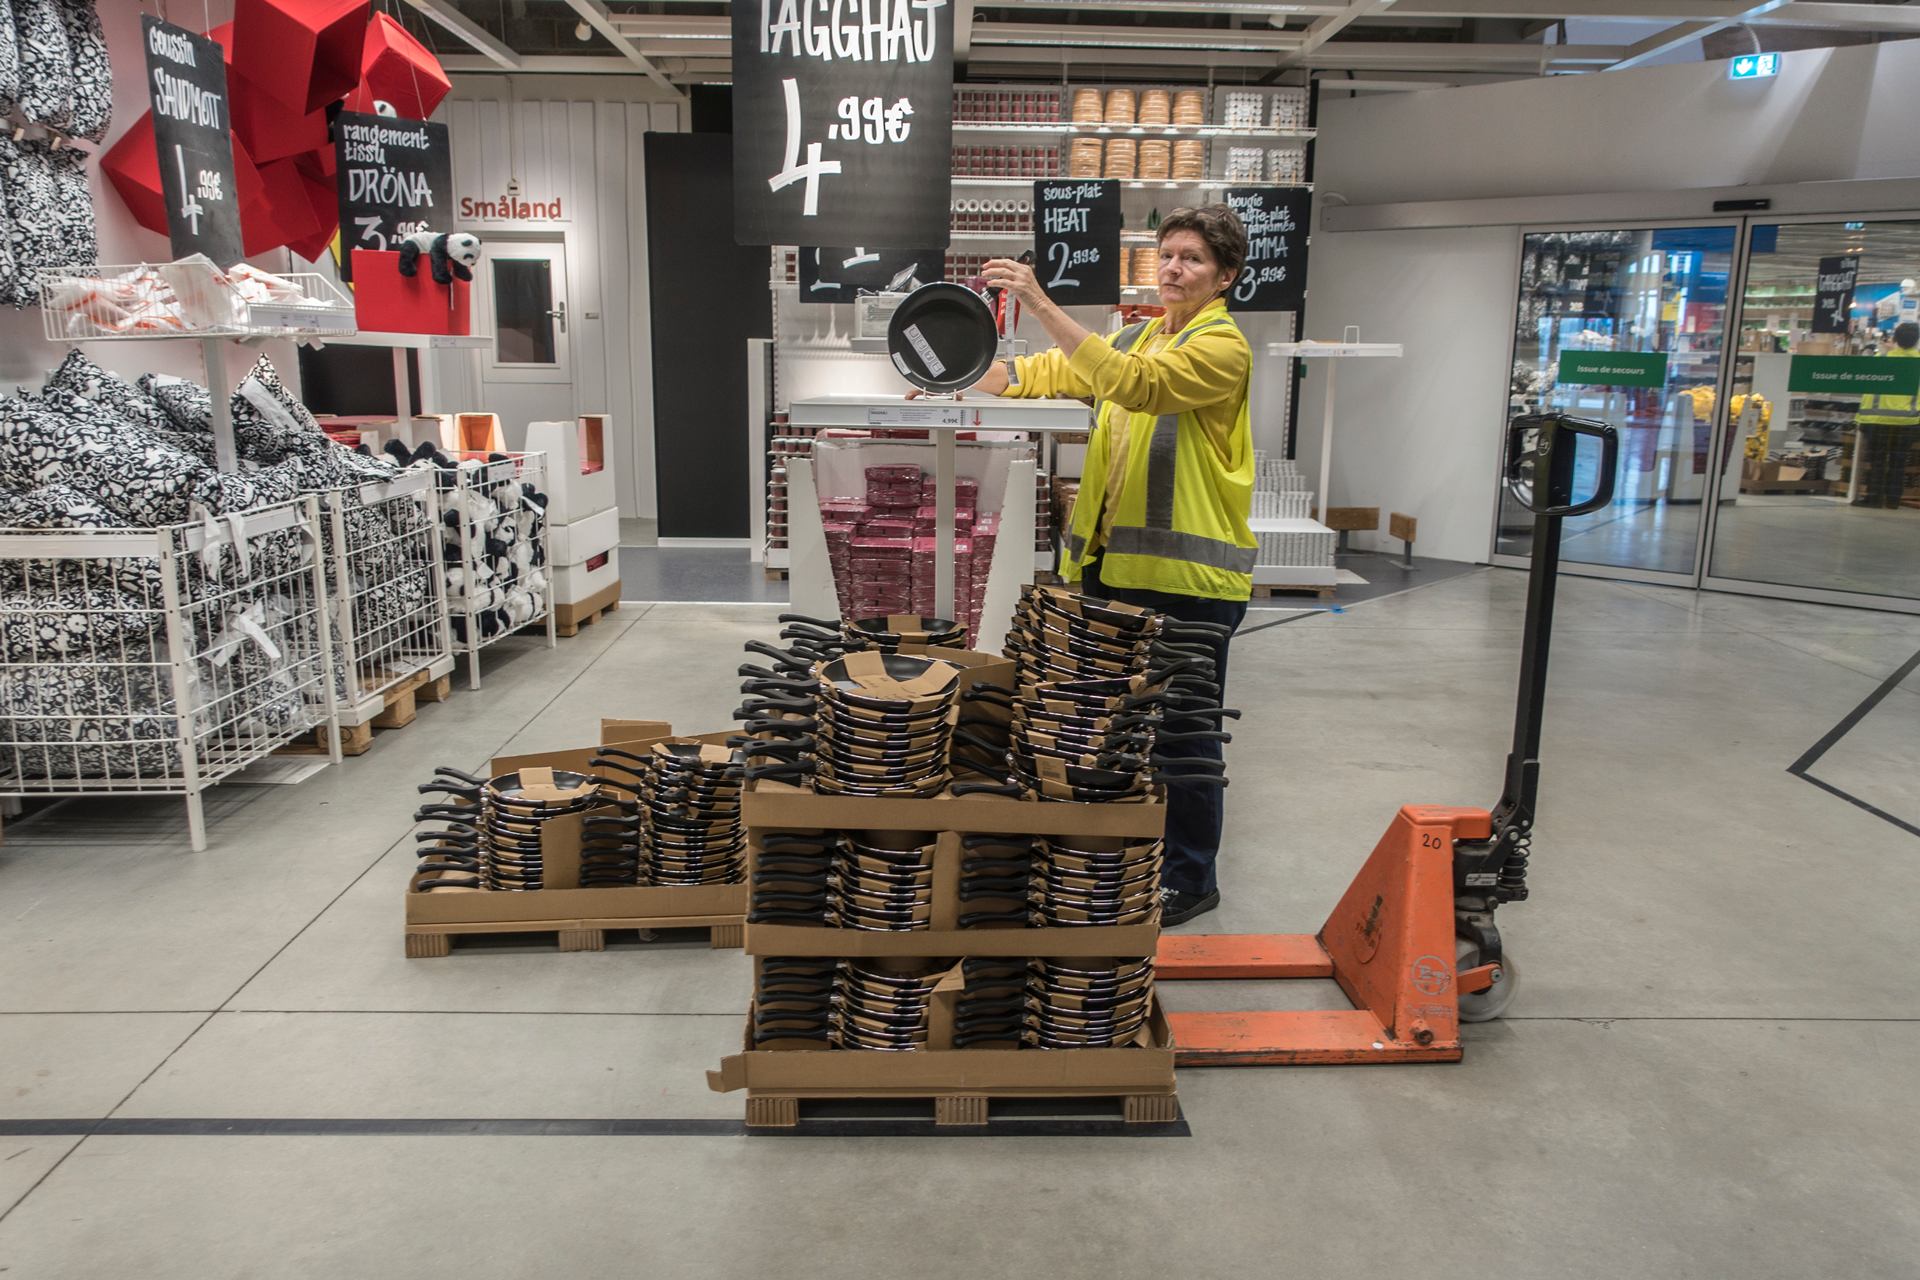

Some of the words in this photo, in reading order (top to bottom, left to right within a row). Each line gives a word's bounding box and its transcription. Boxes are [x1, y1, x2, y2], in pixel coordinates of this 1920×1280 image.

[149, 26, 196, 68] coussin
[154, 67, 221, 129] SANDMOTT
[343, 124, 430, 151] rangement
[344, 141, 386, 165] tissu
[348, 166, 434, 207] DRÖNA
[1043, 182, 1103, 204] sous-plat
[461, 195, 562, 219] Småland
[1227, 192, 1264, 211] bougie
[1043, 207, 1091, 234] HEAT
[1577, 365, 1598, 374] Issue
[1600, 366, 1611, 374] de
[1611, 367, 1646, 375] secours
[1812, 371, 1838, 380] Issue
[1840, 372, 1853, 380] de
[1855, 373, 1895, 382] secours
[1422, 833, 1442, 850] 20
